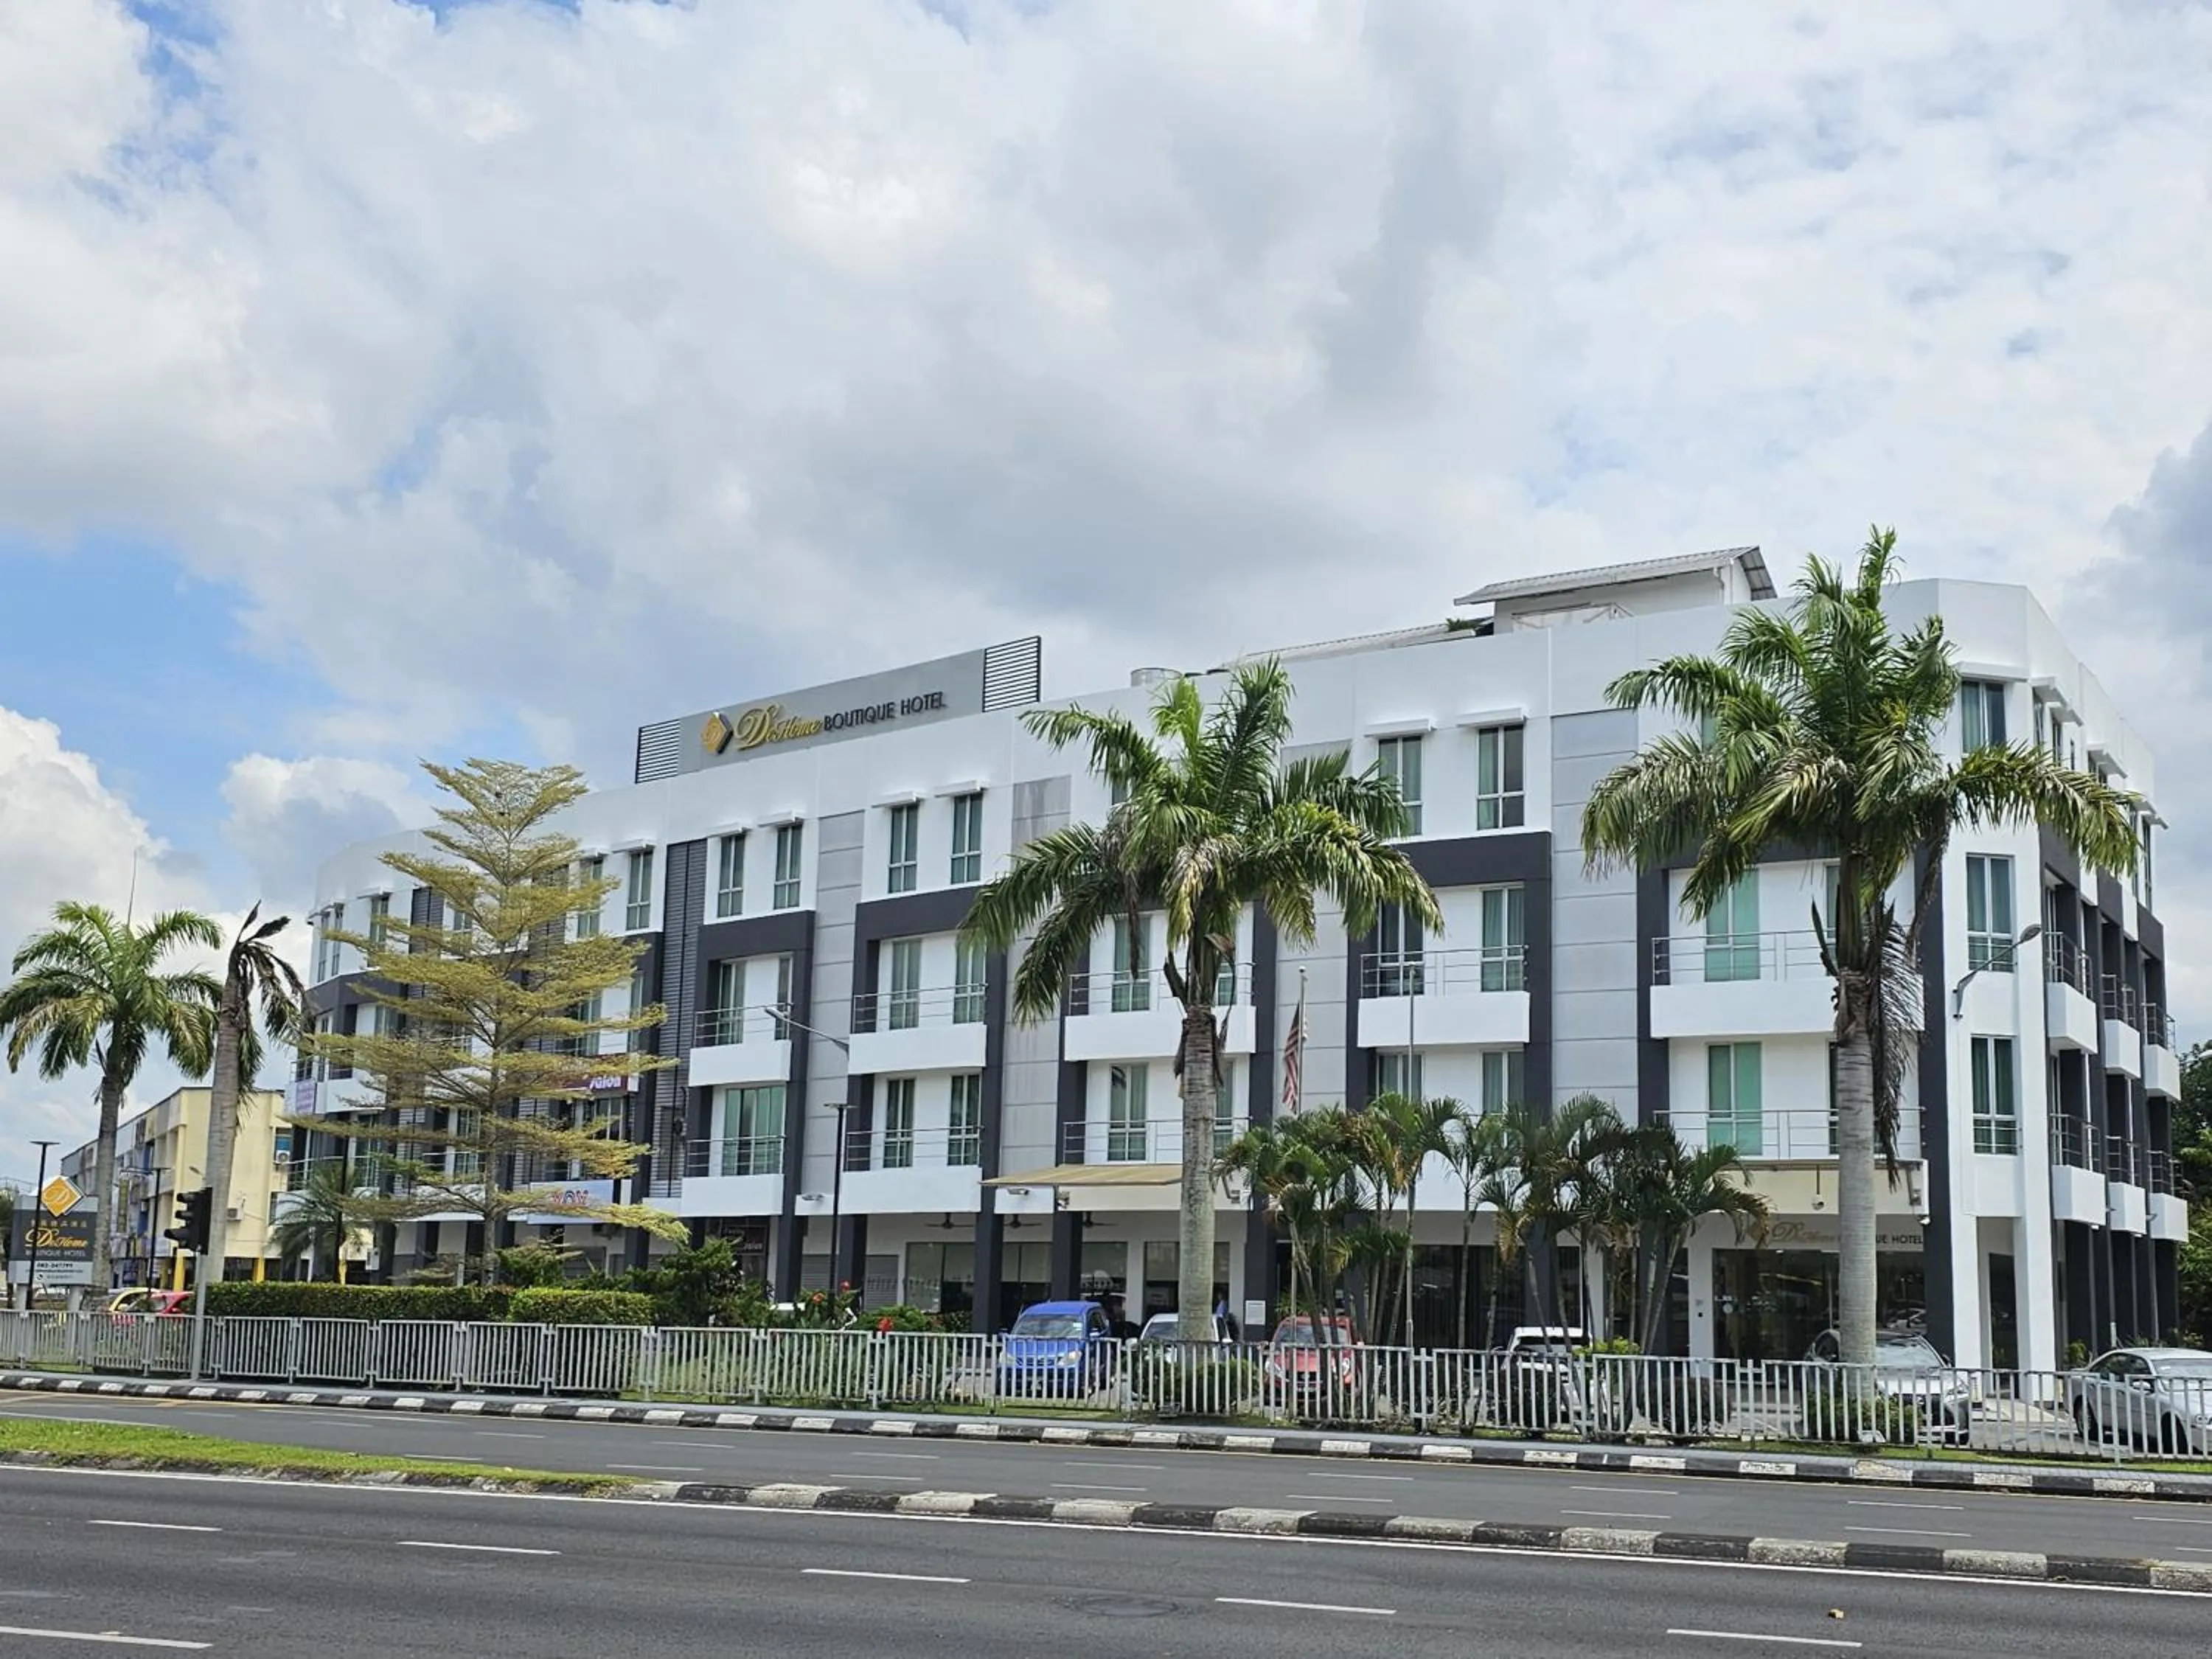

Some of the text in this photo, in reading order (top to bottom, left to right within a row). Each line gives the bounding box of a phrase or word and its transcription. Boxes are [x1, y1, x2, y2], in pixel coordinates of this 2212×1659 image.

[824, 701, 894, 731] BOUTIQUE
[900, 692, 945, 714] HOTEL
[1892, 1234, 1924, 1245] HOTEL
